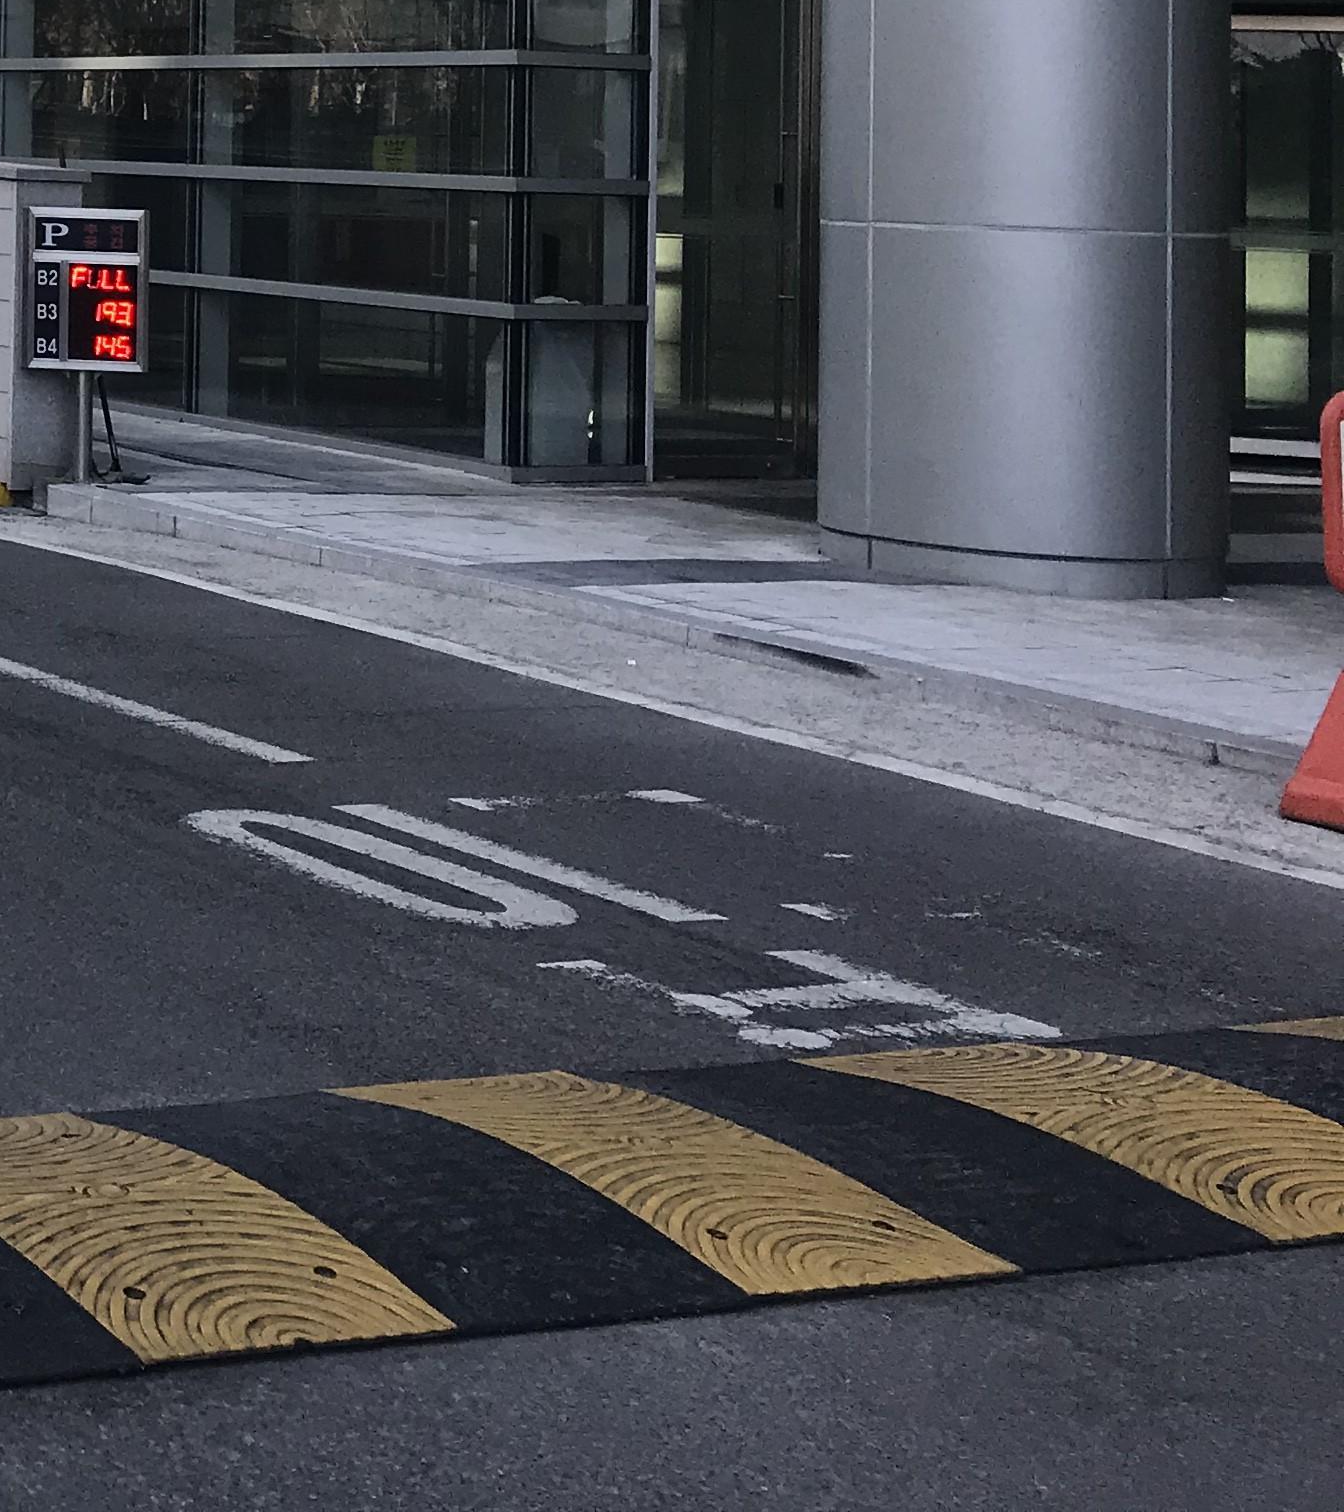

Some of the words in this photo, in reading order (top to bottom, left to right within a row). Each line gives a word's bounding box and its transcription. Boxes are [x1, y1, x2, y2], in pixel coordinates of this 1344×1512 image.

[41, 222, 69, 246] P
[37, 270, 58, 286] B2
[37, 303, 58, 320] B3
[95, 301, 134, 326] 193
[36, 338, 58, 354] B4
[95, 336, 132, 359] 145
